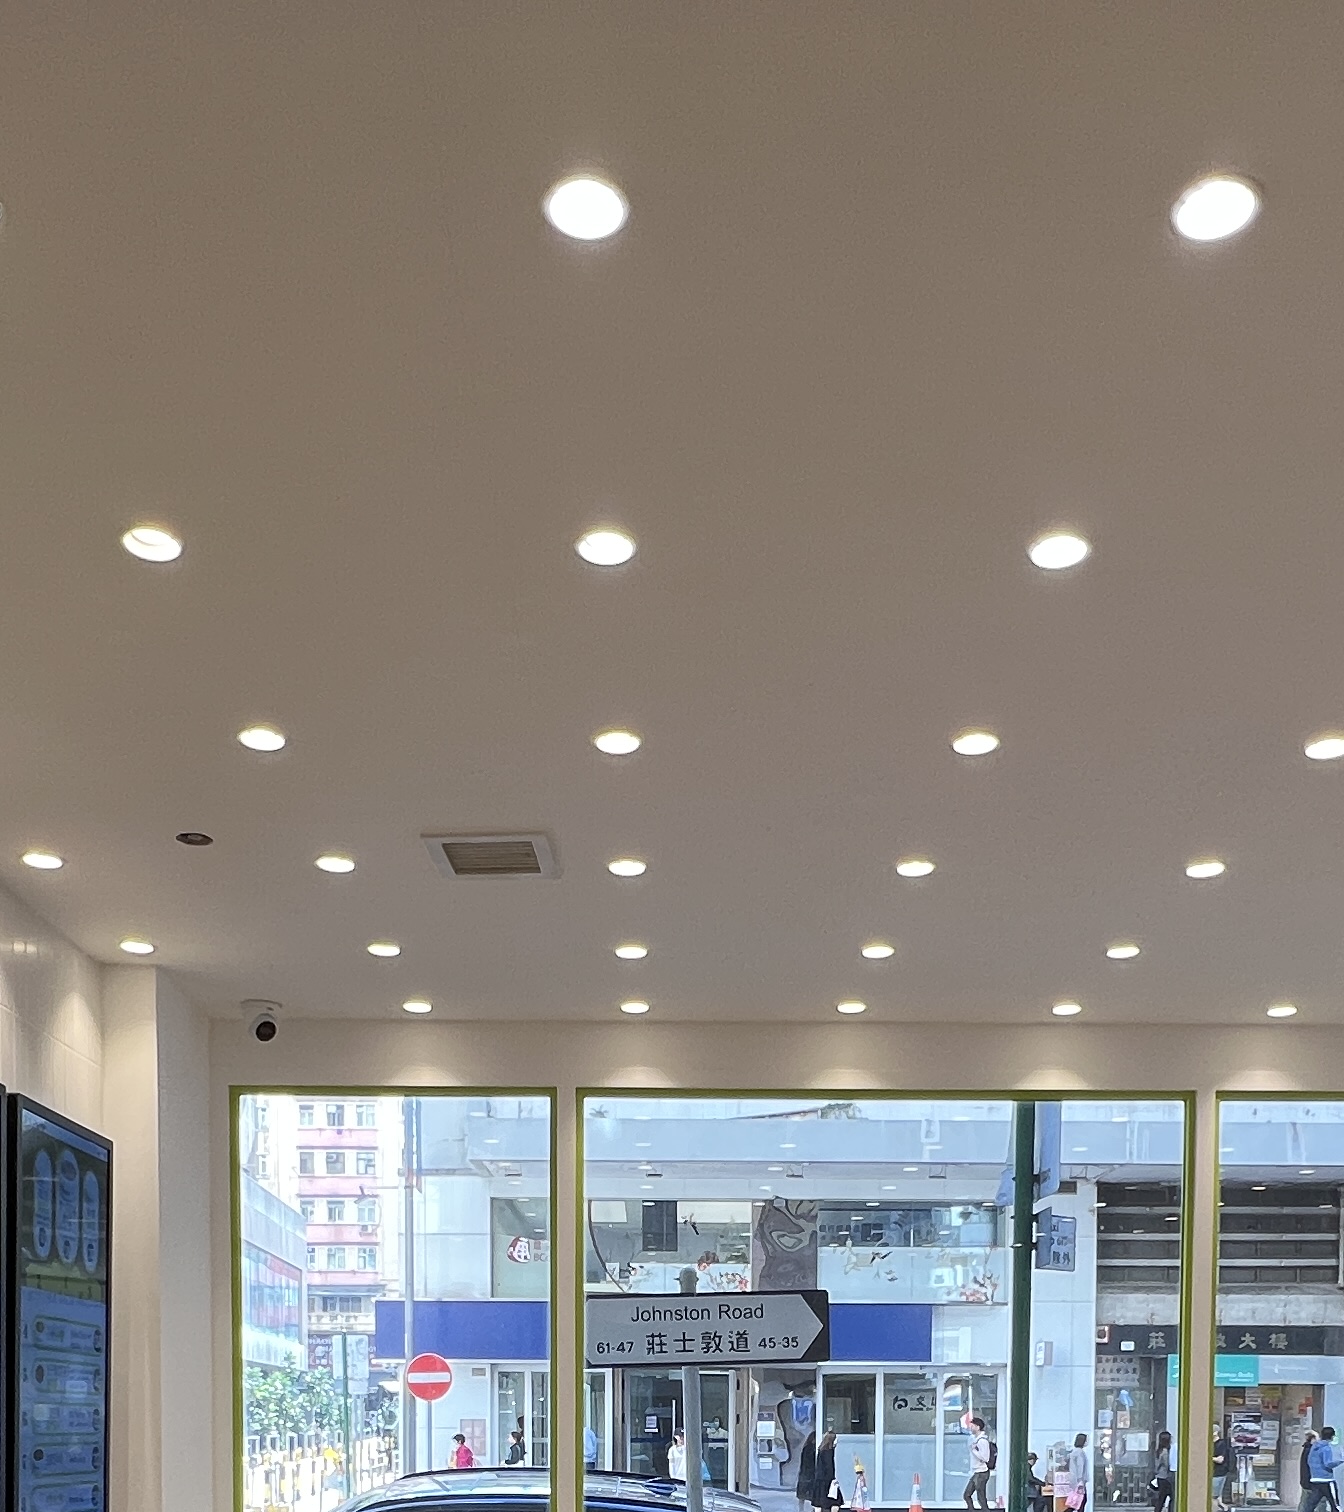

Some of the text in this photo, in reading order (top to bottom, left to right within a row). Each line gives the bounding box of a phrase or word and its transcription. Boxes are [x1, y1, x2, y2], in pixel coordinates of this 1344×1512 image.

[631, 1303, 765, 1323] Johnston Road
[596, 1341, 635, 1354] 61-47
[645, 1330, 751, 1355] 莊士敦道
[757, 1336, 799, 1350] 45-35
